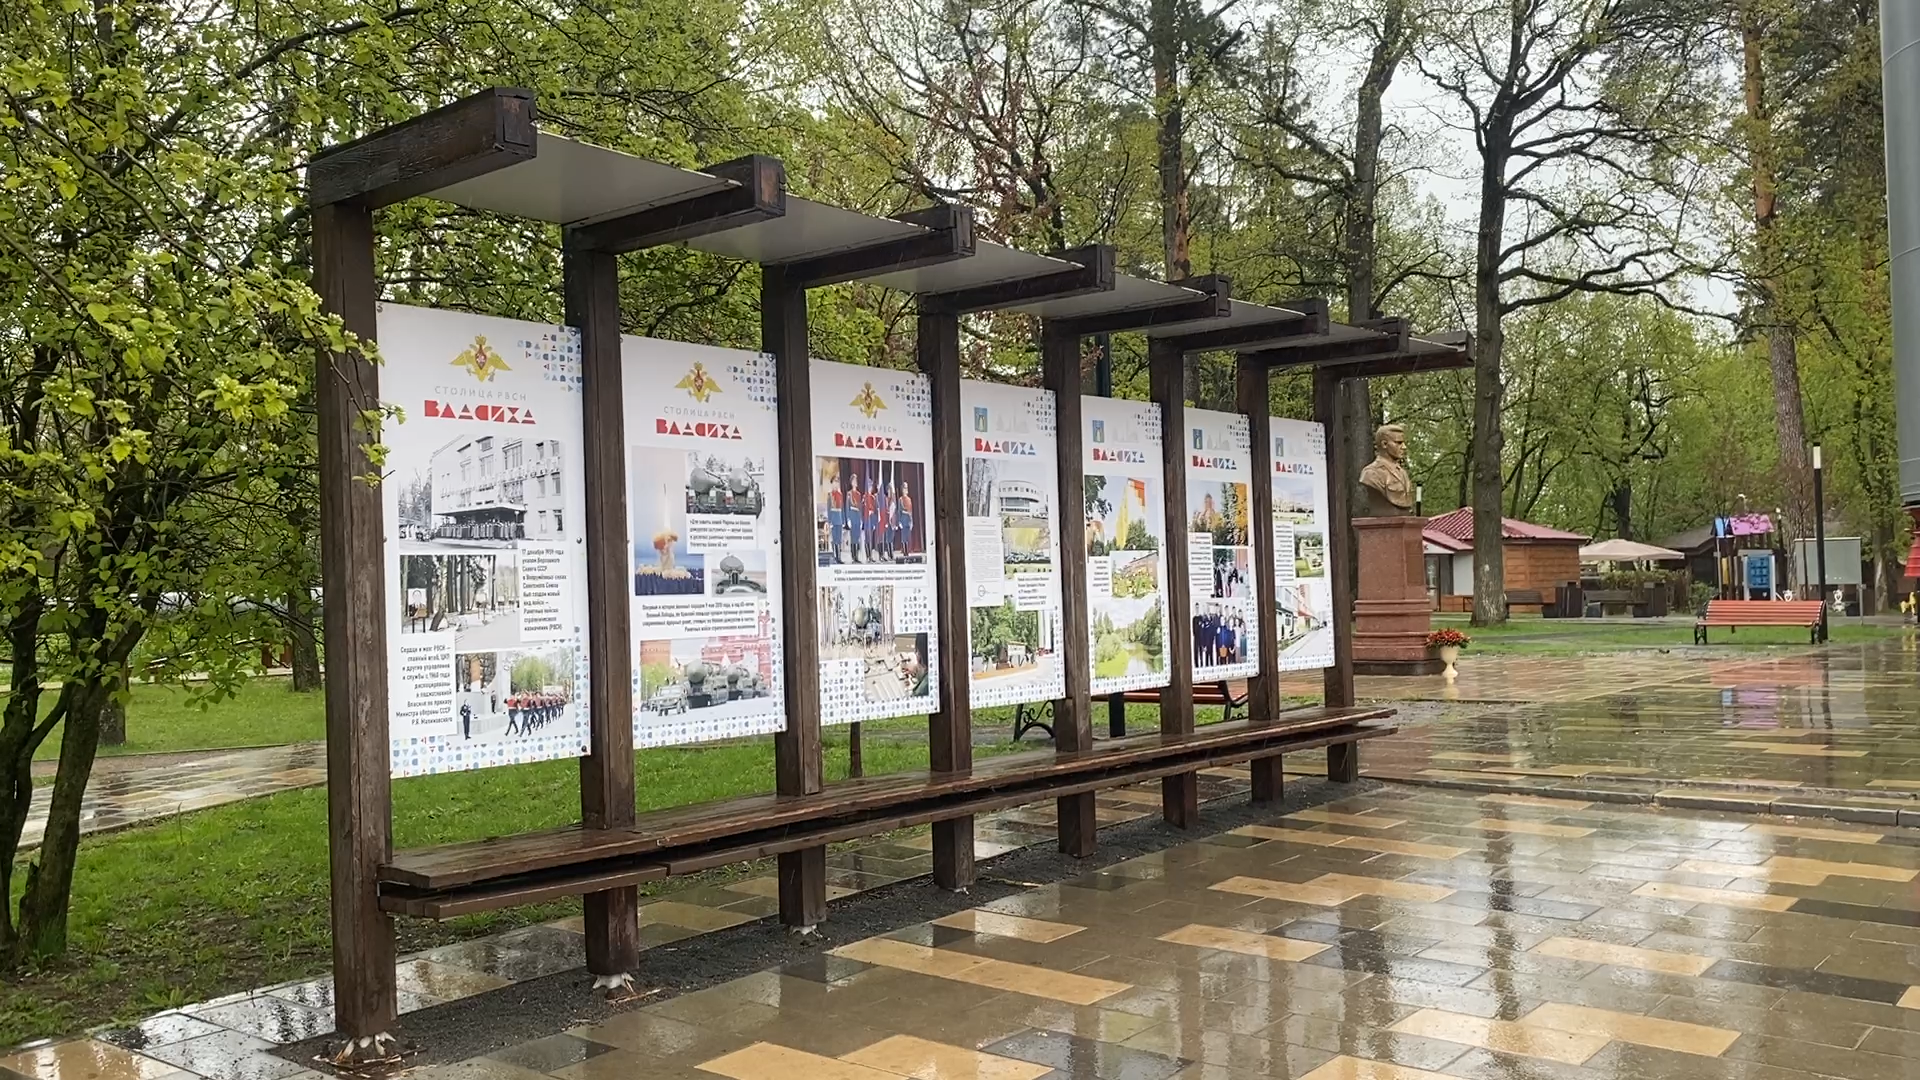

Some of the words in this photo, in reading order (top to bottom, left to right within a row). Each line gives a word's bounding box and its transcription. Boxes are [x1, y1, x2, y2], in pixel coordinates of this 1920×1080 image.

[434, 385, 493, 398] СТОЛИЦА
[497, 391, 527, 401] РВСН
[424, 400, 536, 425] ВЛАСИХА
[663, 406, 709, 417] СТОЛИЦА
[712, 411, 735, 420] РВСН
[656, 418, 742, 440] ВЛАСИХА
[840, 421, 876, 432] СТОЛИЦА
[834, 432, 903, 451] ВЛАСИХА
[975, 438, 1036, 455] ВЛАСИХА
[1093, 448, 1145, 463] ВЛАСИХА
[1192, 456, 1236, 470] ВЛАСИХА
